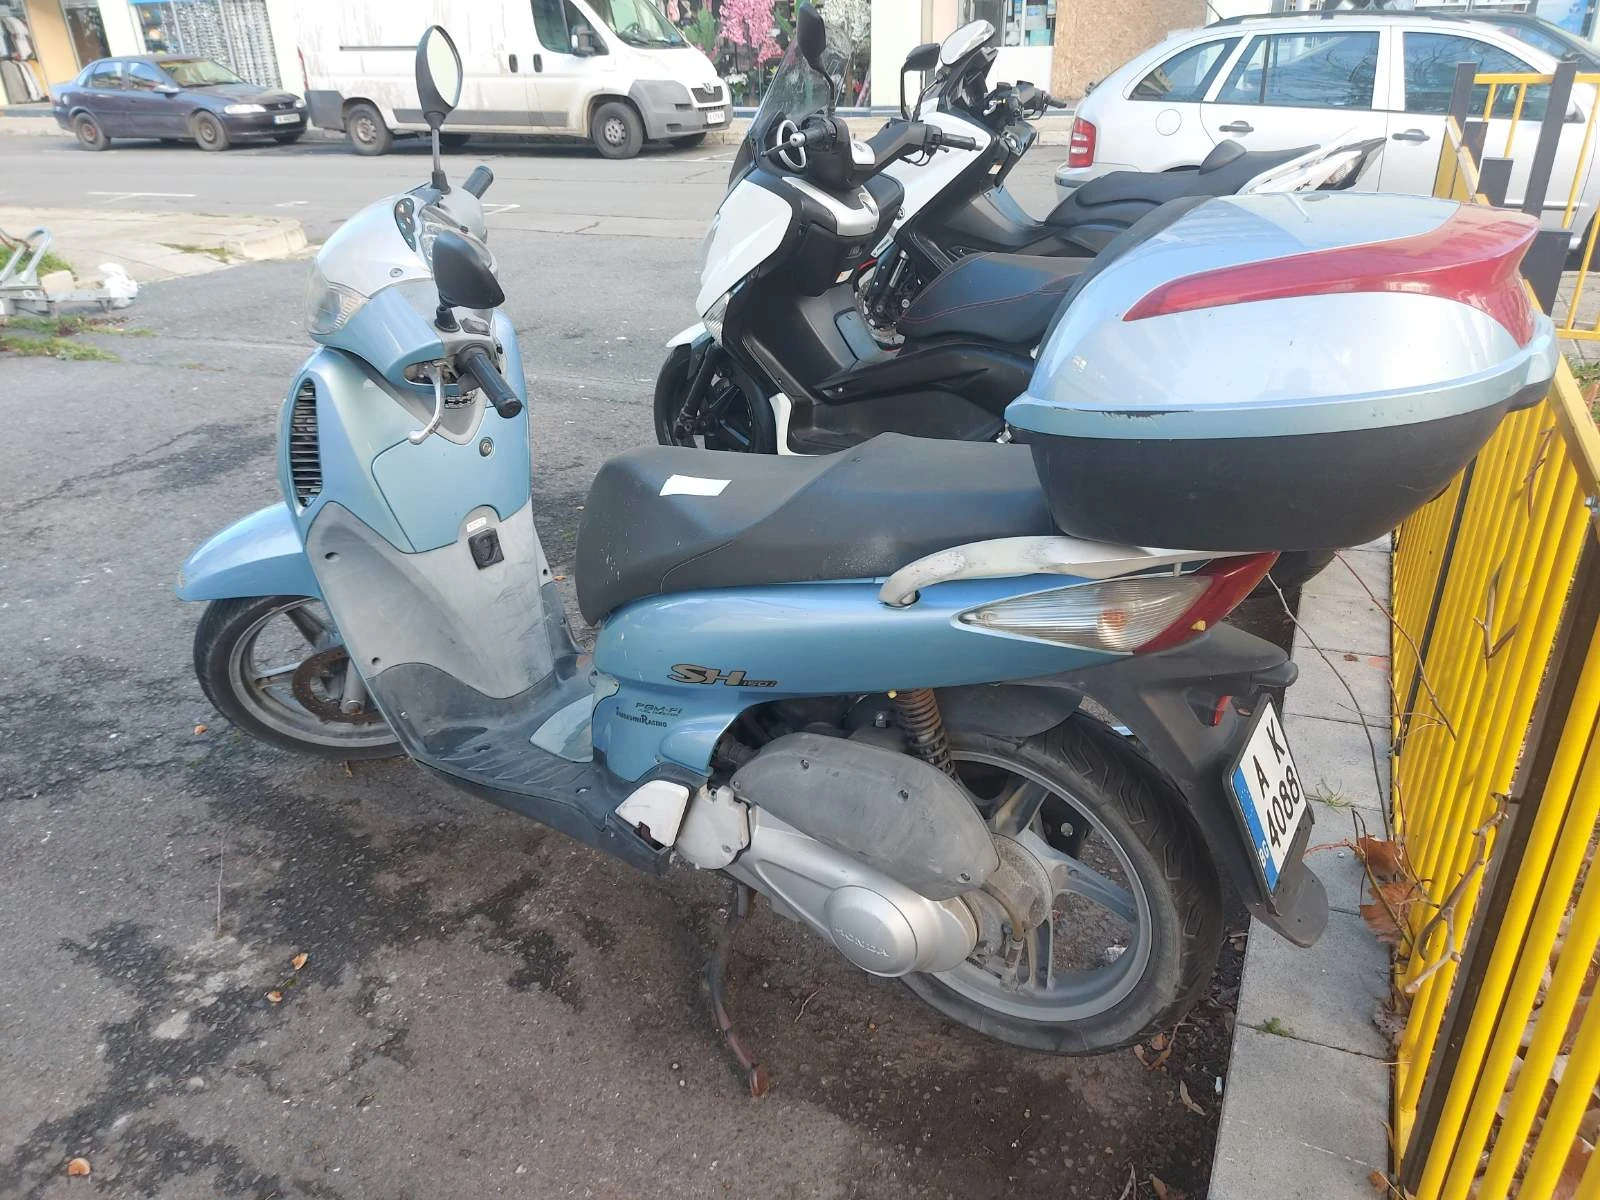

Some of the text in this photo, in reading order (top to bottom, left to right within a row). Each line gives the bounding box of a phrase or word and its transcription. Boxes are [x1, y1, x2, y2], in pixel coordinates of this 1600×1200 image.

[667, 664, 746, 686] SH
[1252, 717, 1285, 799] A K
[1266, 765, 1300, 849] 4088
[1258, 840, 1270, 868] BG
